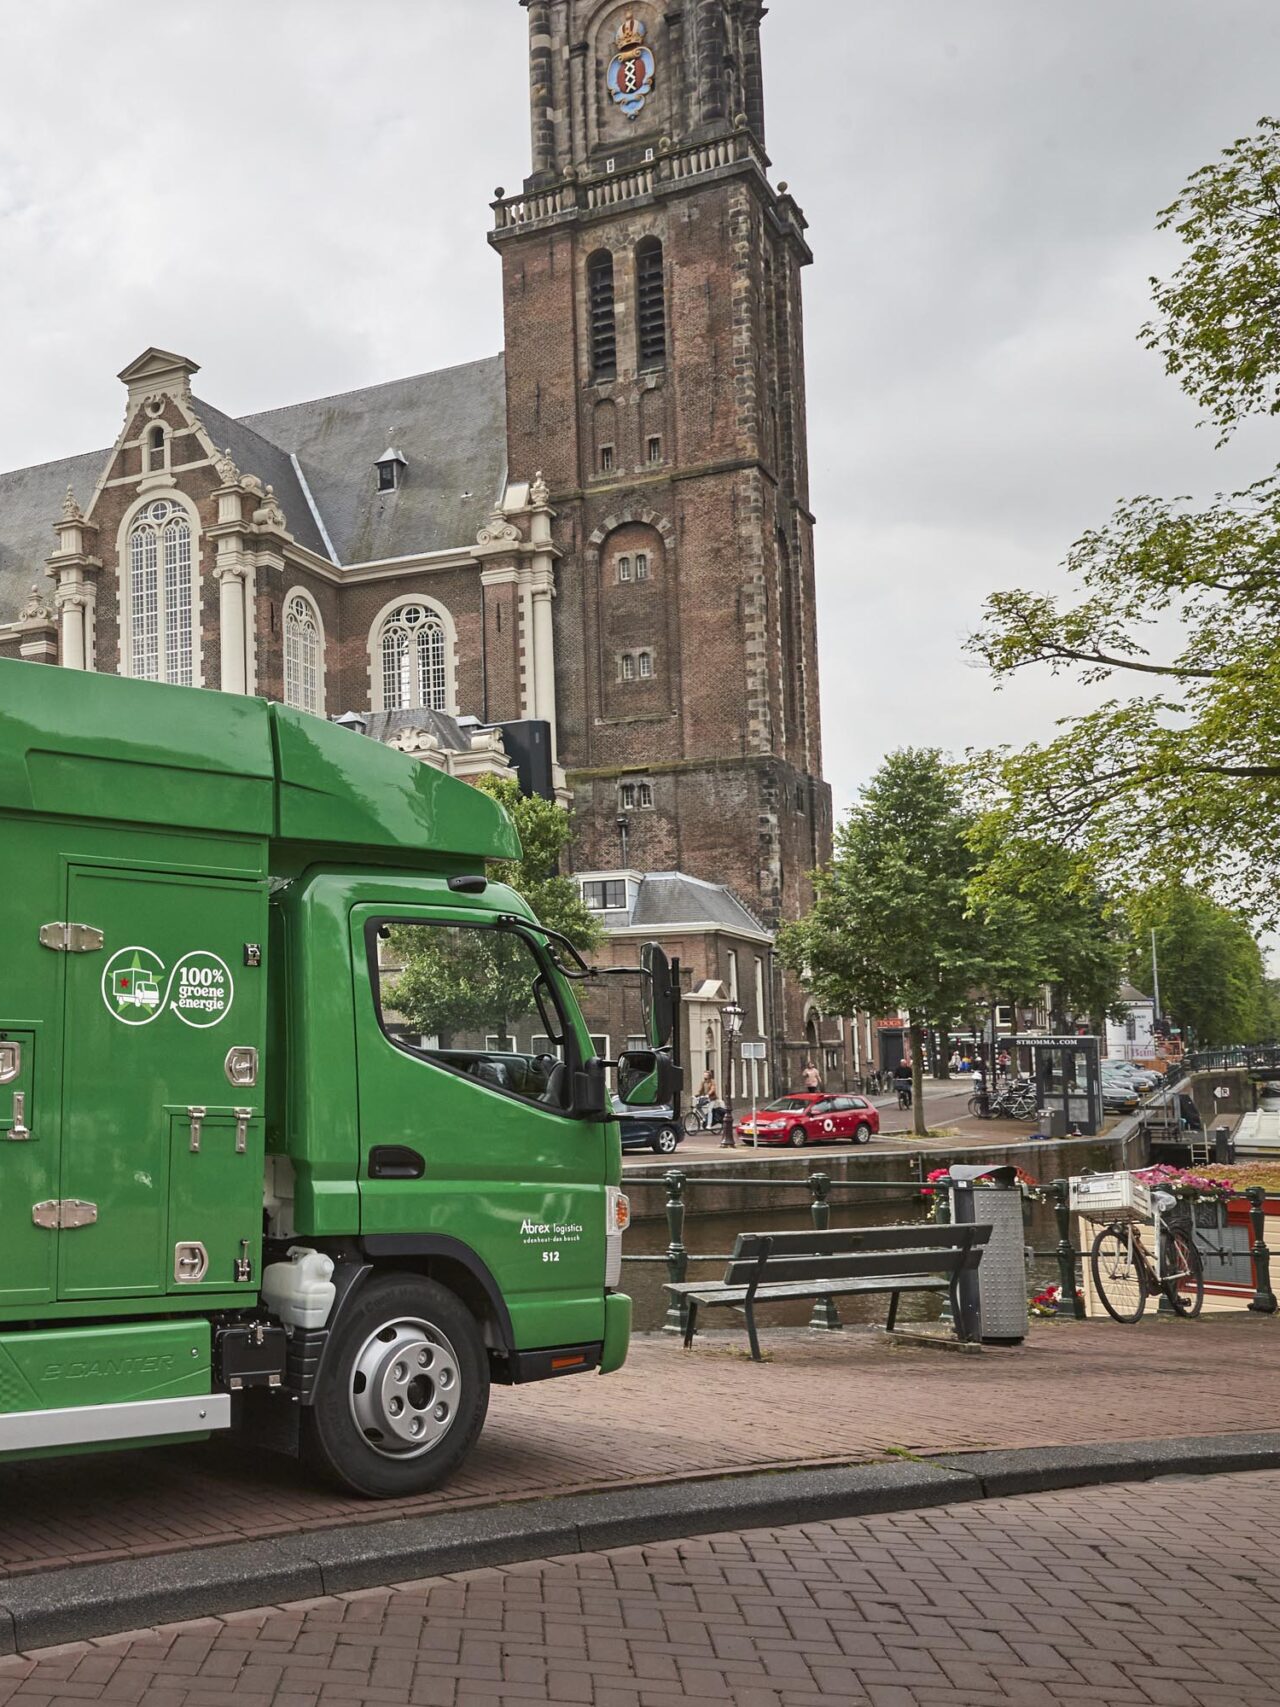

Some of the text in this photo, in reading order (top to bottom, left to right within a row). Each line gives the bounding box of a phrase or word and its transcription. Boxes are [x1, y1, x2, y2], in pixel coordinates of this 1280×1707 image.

[179, 967, 224, 986] 100%
[178, 985, 224, 998] groene
[178, 997, 224, 1012] energie
[520, 1219, 583, 1235] Abrex logistics
[542, 1251, 560, 1262] 512
